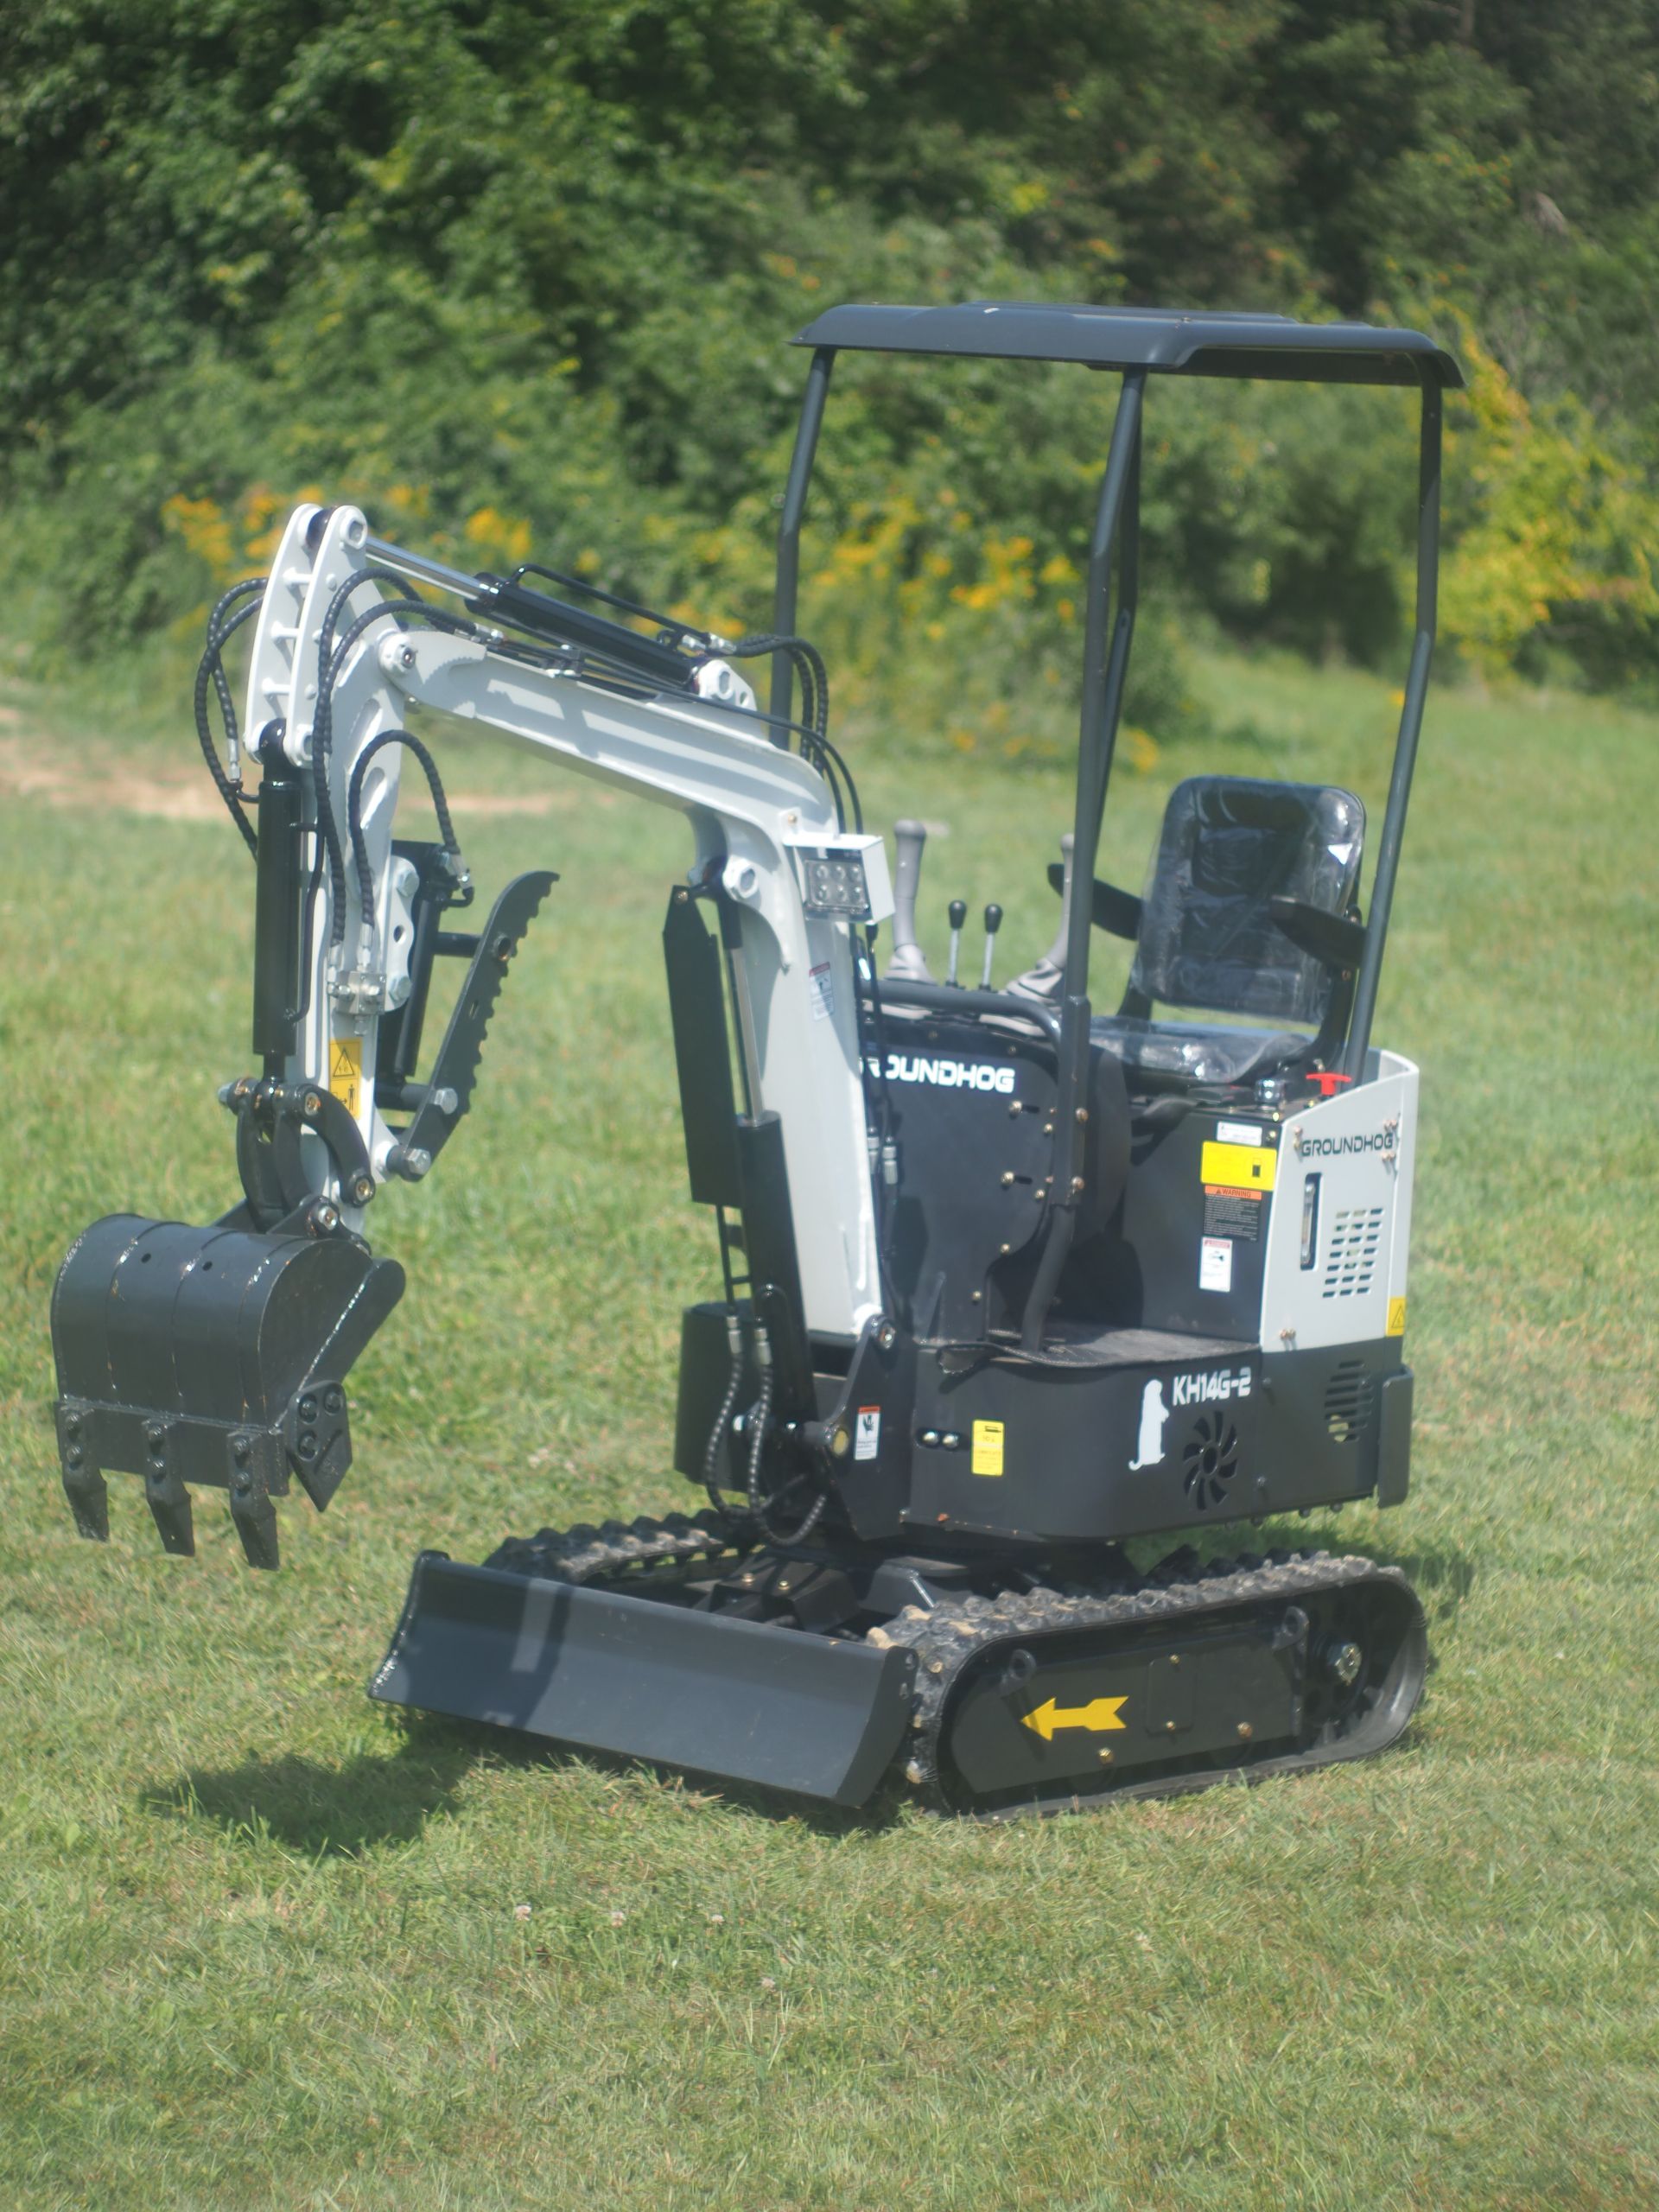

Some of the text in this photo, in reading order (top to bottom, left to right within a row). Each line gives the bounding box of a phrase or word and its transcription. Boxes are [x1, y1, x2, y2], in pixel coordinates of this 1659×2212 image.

[1301, 1132, 1393, 1157] GROUNDHOG
[1222, 1188, 1251, 1198] WARNING
[1173, 1366, 1251, 1407] KH14G-2
